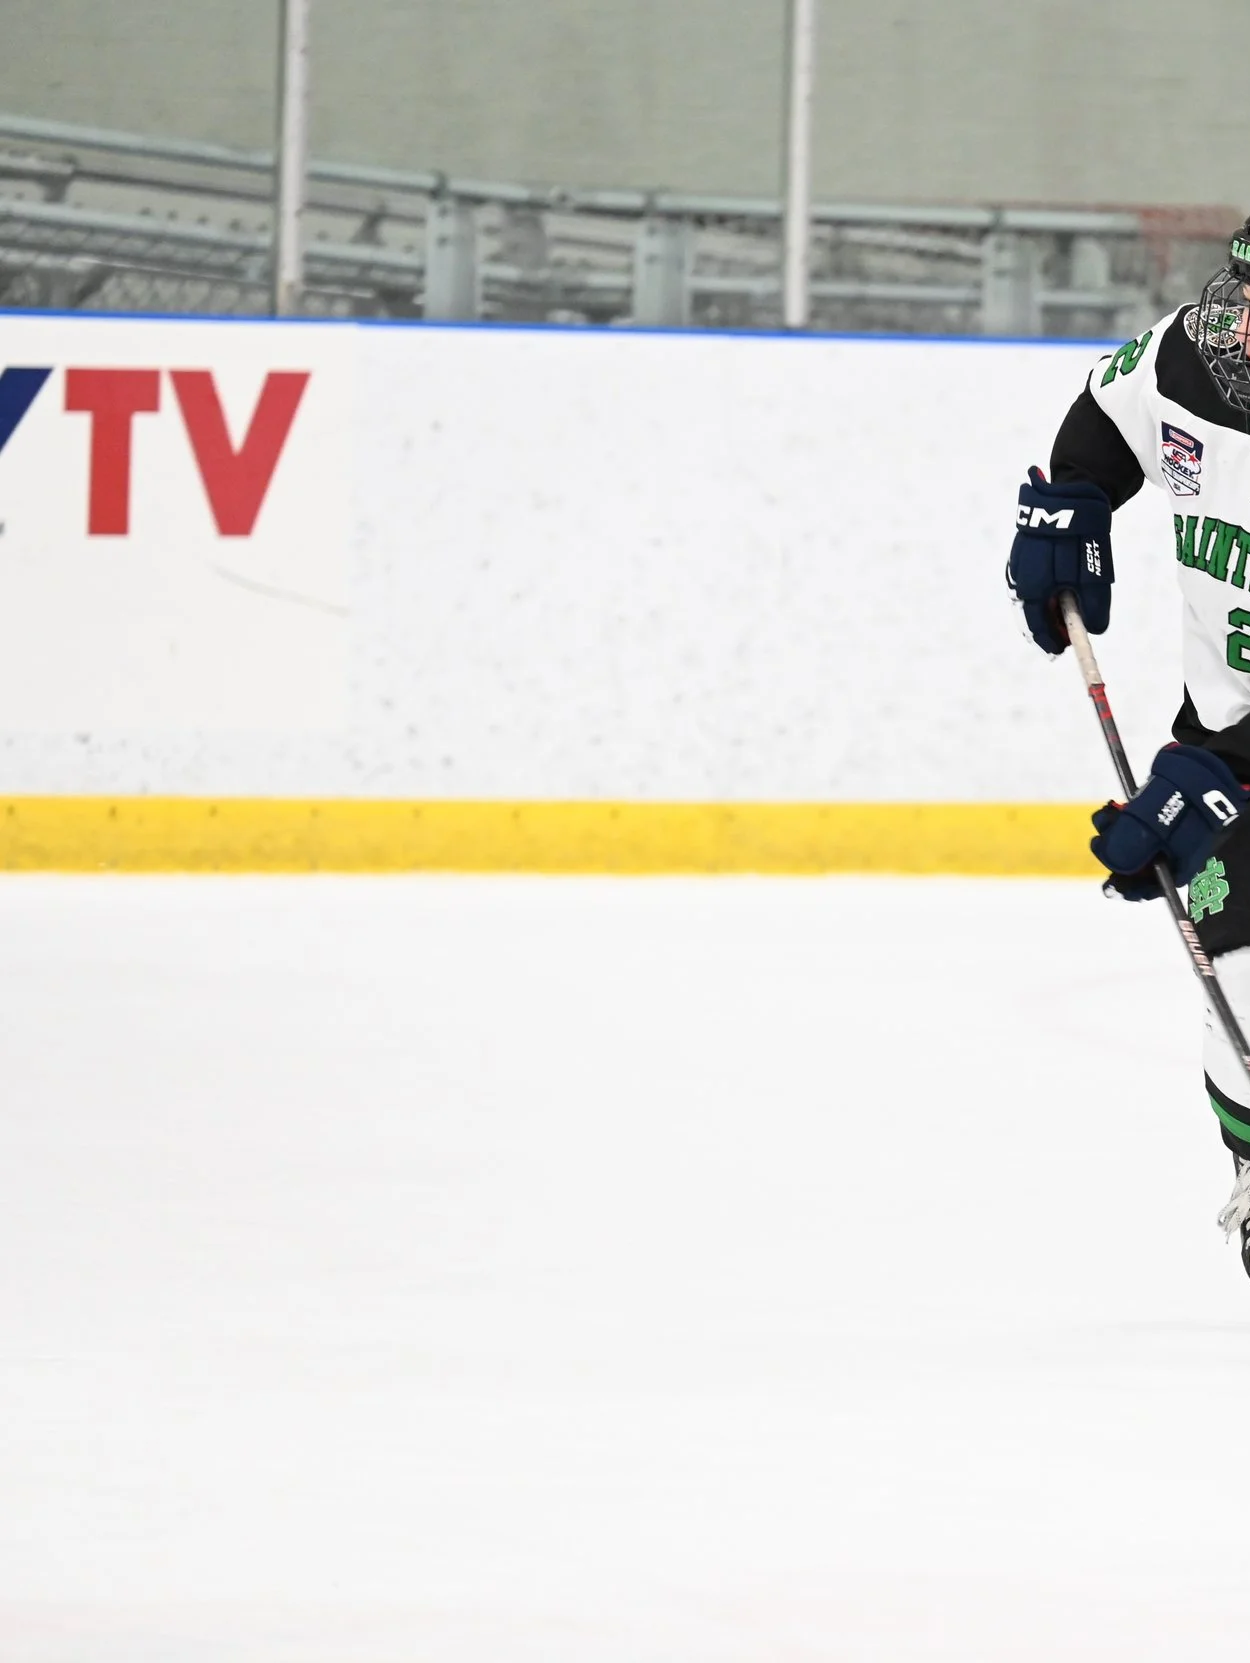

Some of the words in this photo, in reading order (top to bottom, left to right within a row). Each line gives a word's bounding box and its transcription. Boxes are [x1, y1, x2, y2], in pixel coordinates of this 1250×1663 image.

[1100, 330, 1154, 388] 2
[1164, 455, 1195, 477] HOCKEY
[1085, 542, 1095, 574] CCM
[1092, 539, 1102, 576] NEXT
